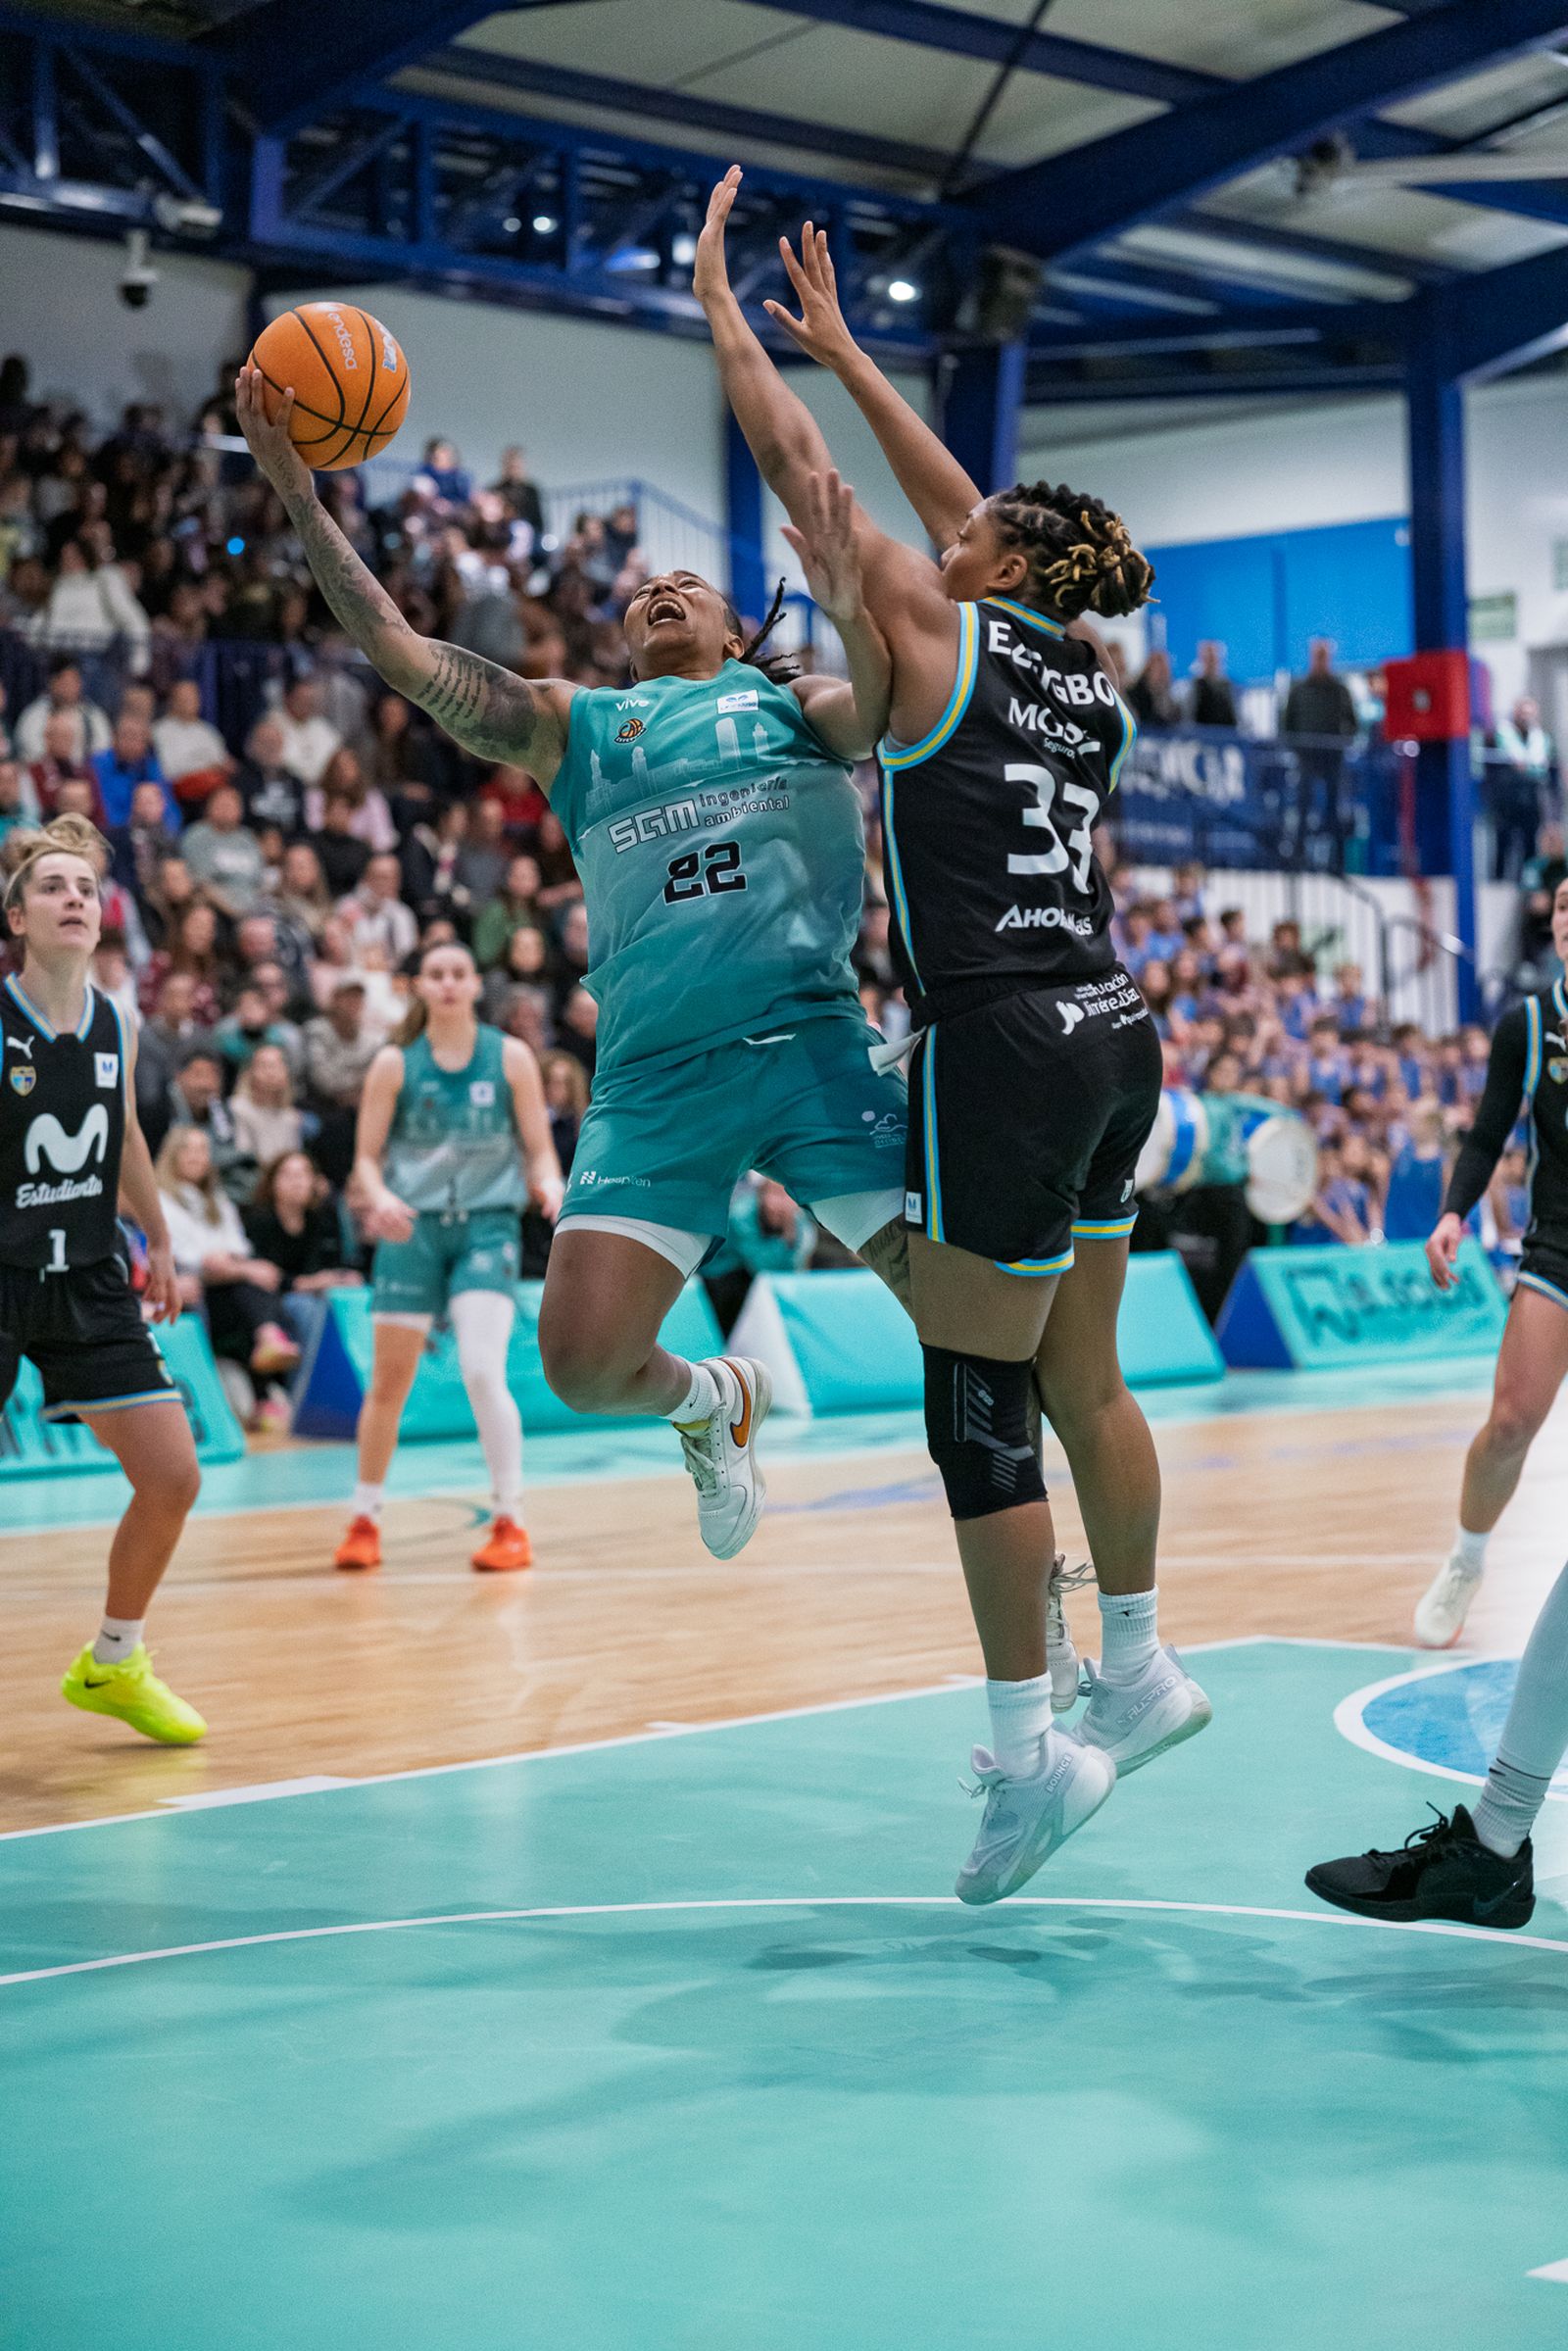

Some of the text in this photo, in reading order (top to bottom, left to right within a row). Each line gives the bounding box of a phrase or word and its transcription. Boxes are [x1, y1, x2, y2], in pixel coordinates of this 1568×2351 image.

[329, 313, 357, 369] endesa
[608, 799, 701, 855] SGM
[704, 795, 790, 828] ambiental
[662, 840, 748, 906] 22
[45, 1229, 70, 1272] 1
